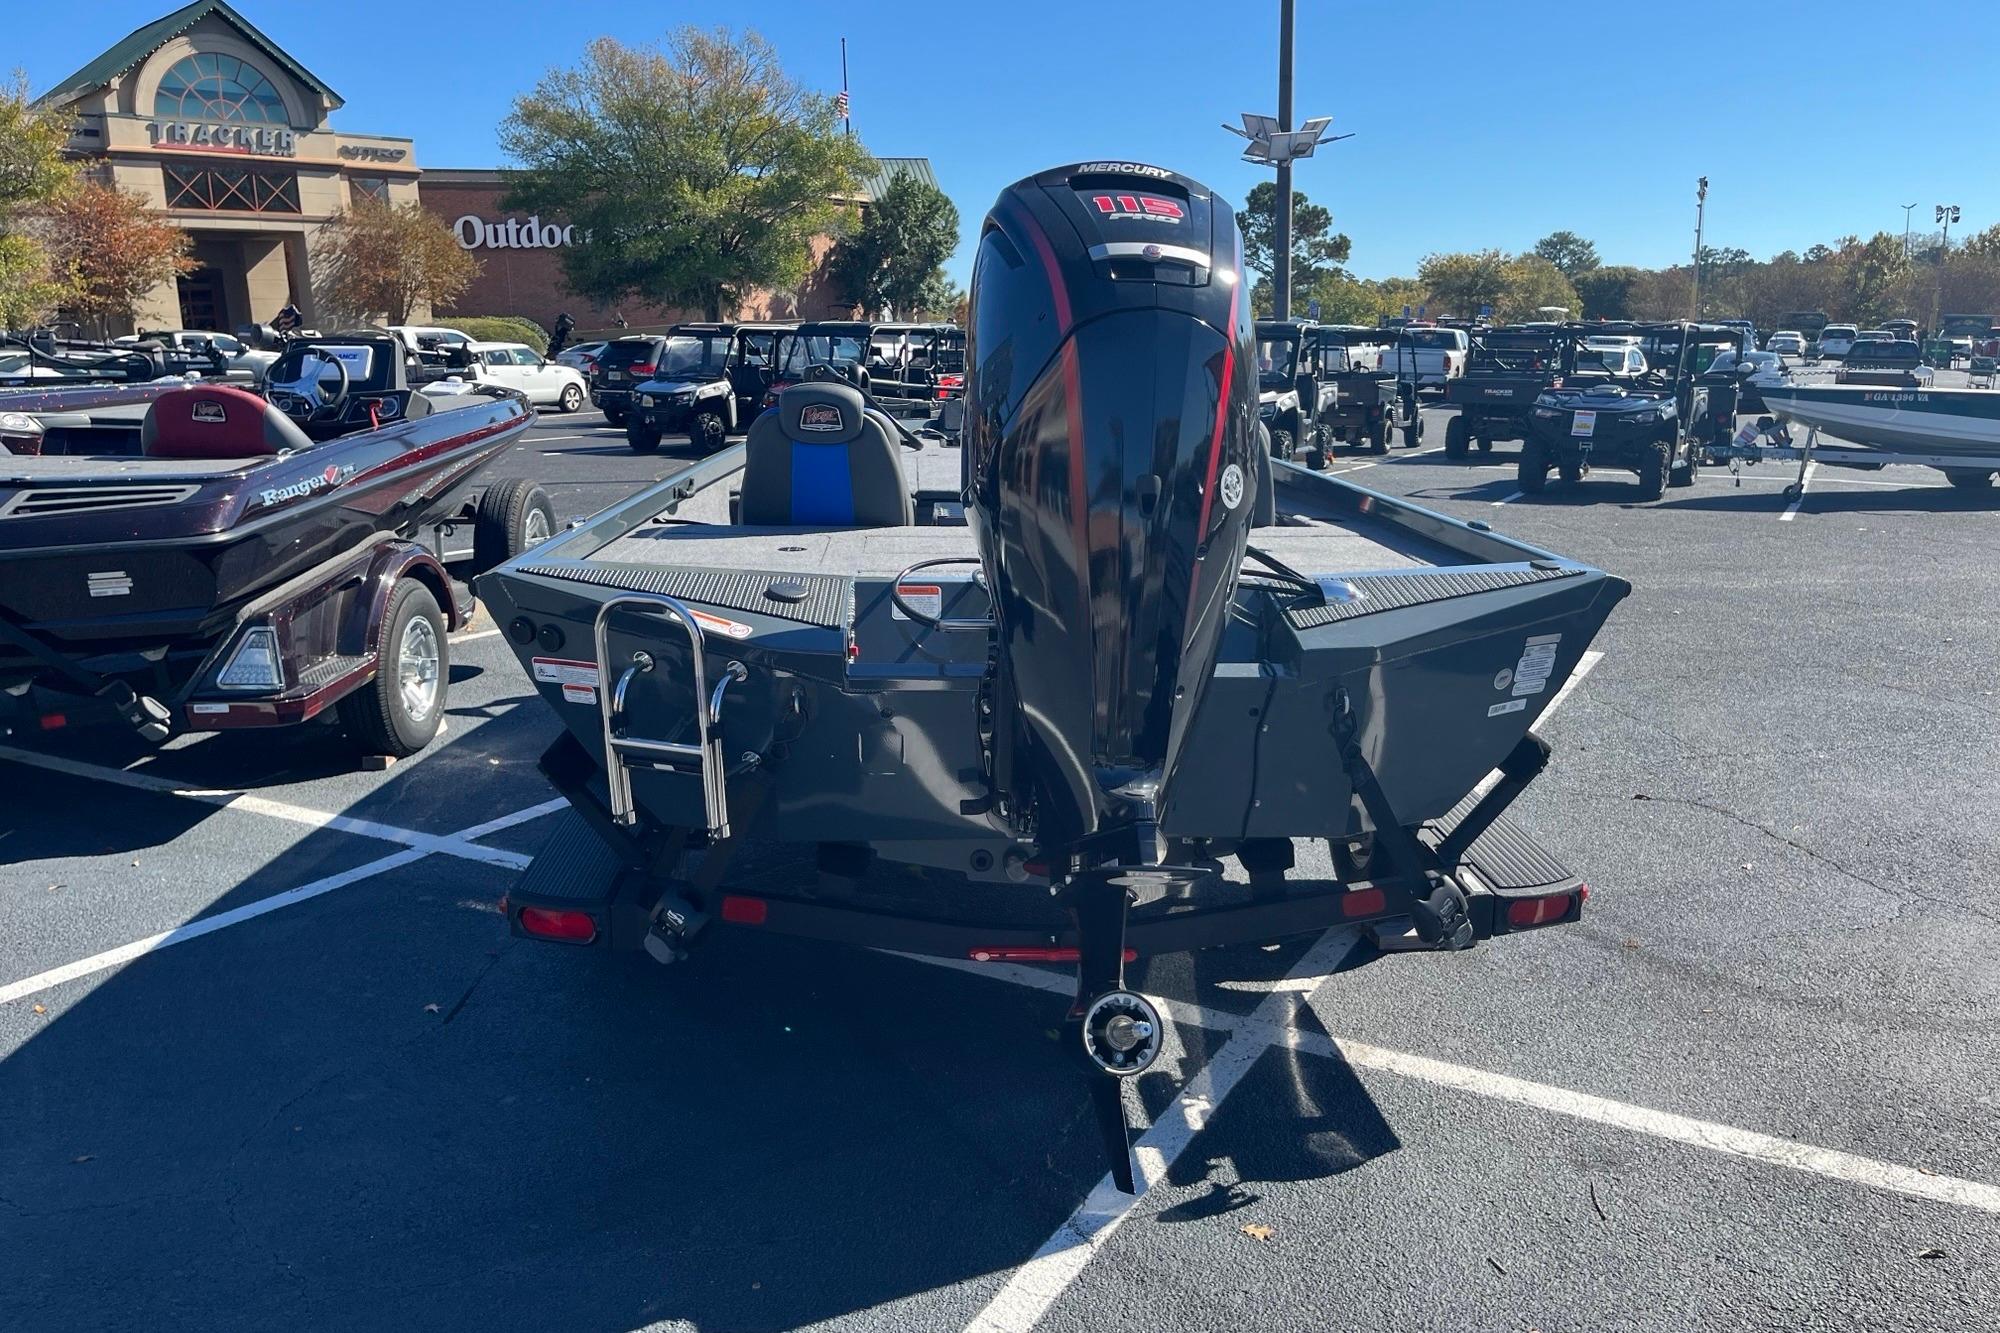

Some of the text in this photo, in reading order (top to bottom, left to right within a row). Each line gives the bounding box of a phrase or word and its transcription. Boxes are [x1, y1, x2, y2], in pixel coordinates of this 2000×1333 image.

[147, 121, 295, 152] TRACKER
[1078, 163, 1173, 178] MERCURY
[1093, 196, 1184, 218] 115
[1109, 213, 1180, 224] PRO
[260, 474, 327, 506] Ranger
